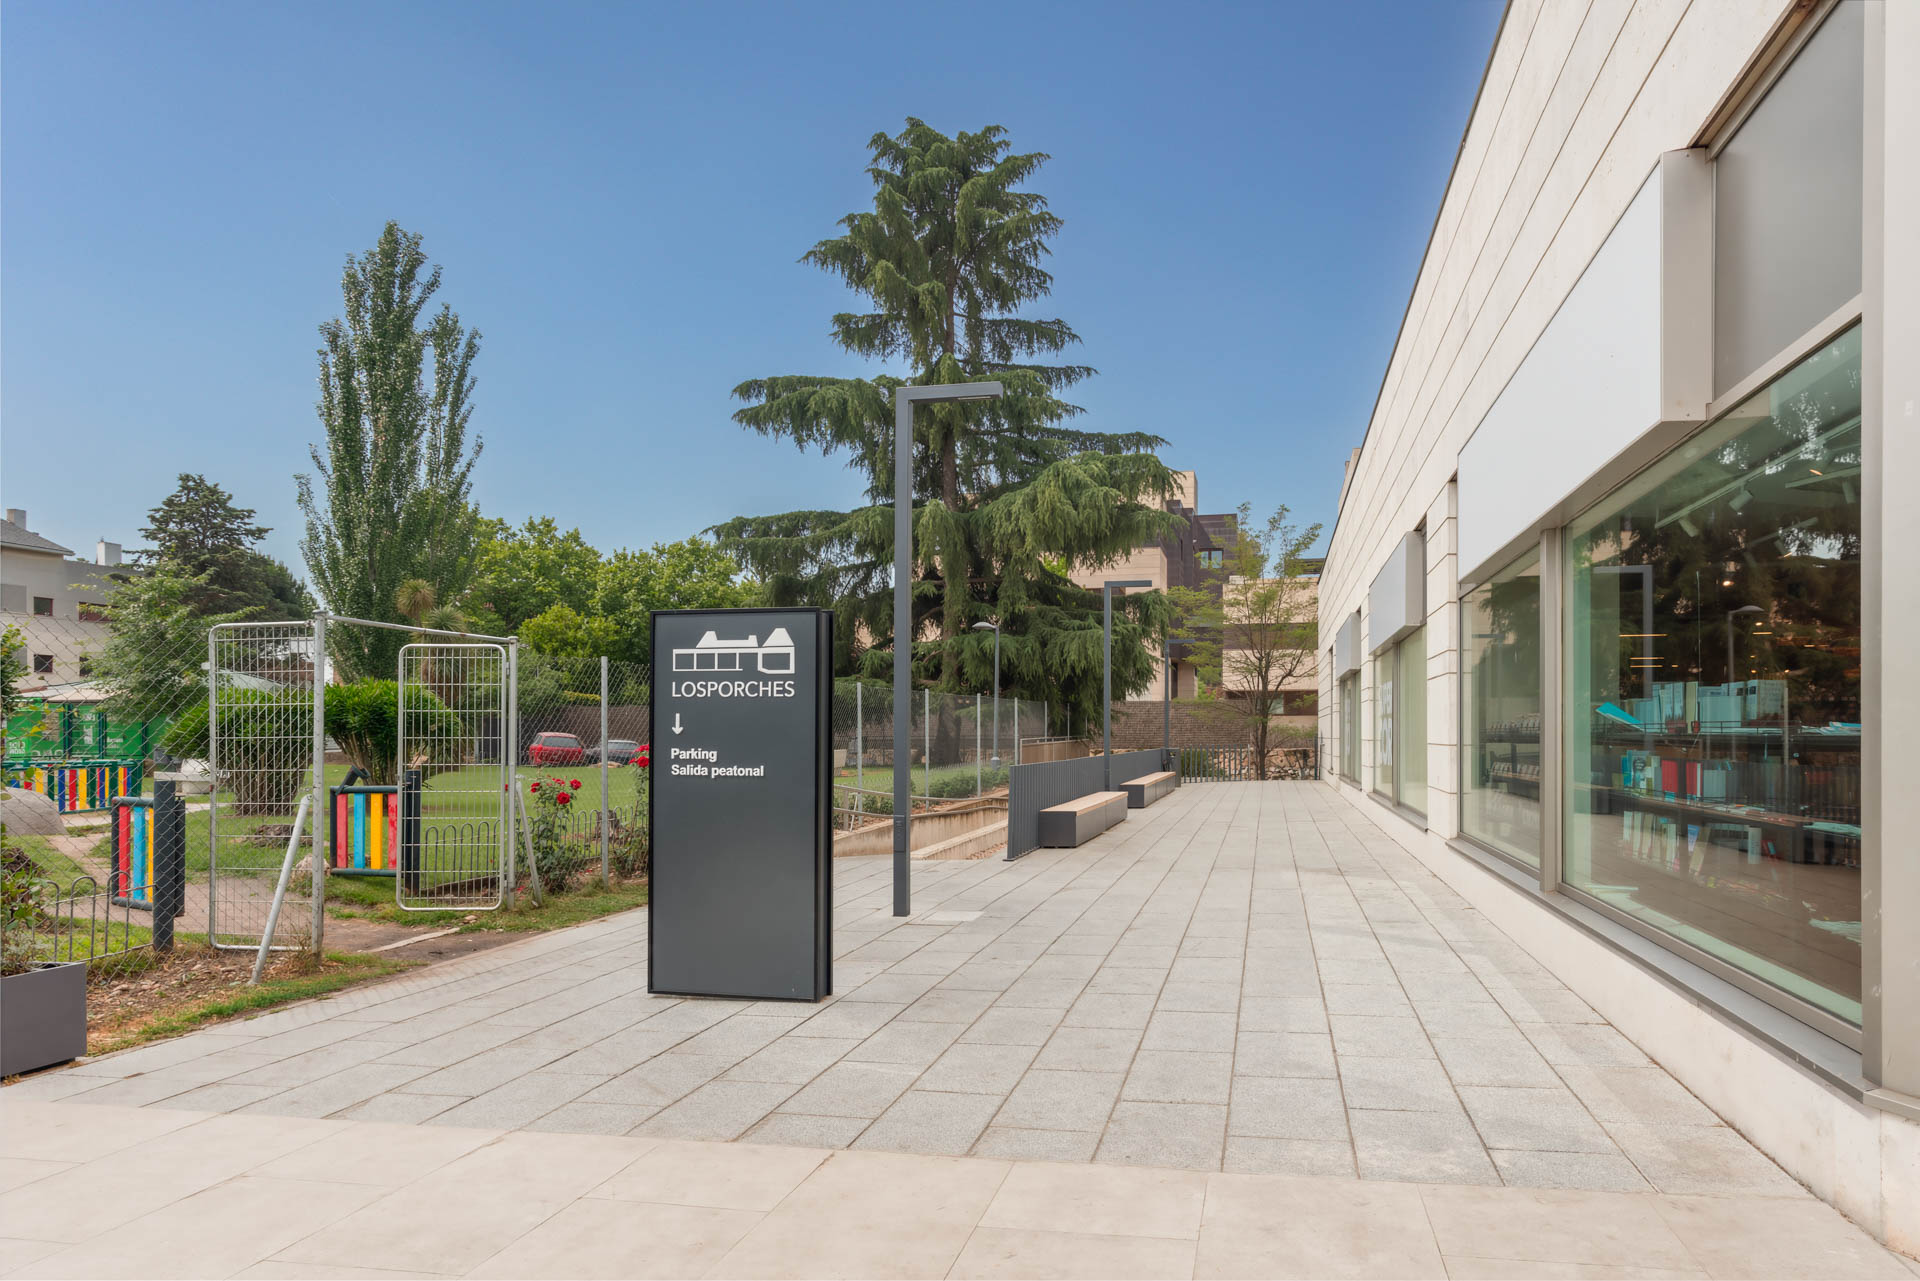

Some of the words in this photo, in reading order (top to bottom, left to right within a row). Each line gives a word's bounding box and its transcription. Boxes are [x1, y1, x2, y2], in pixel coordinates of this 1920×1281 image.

[671, 681, 796, 698] LOSPORCHES
[670, 747, 718, 762] Parking
[671, 764, 709, 776] Salida
[711, 765, 765, 779] peatonal
